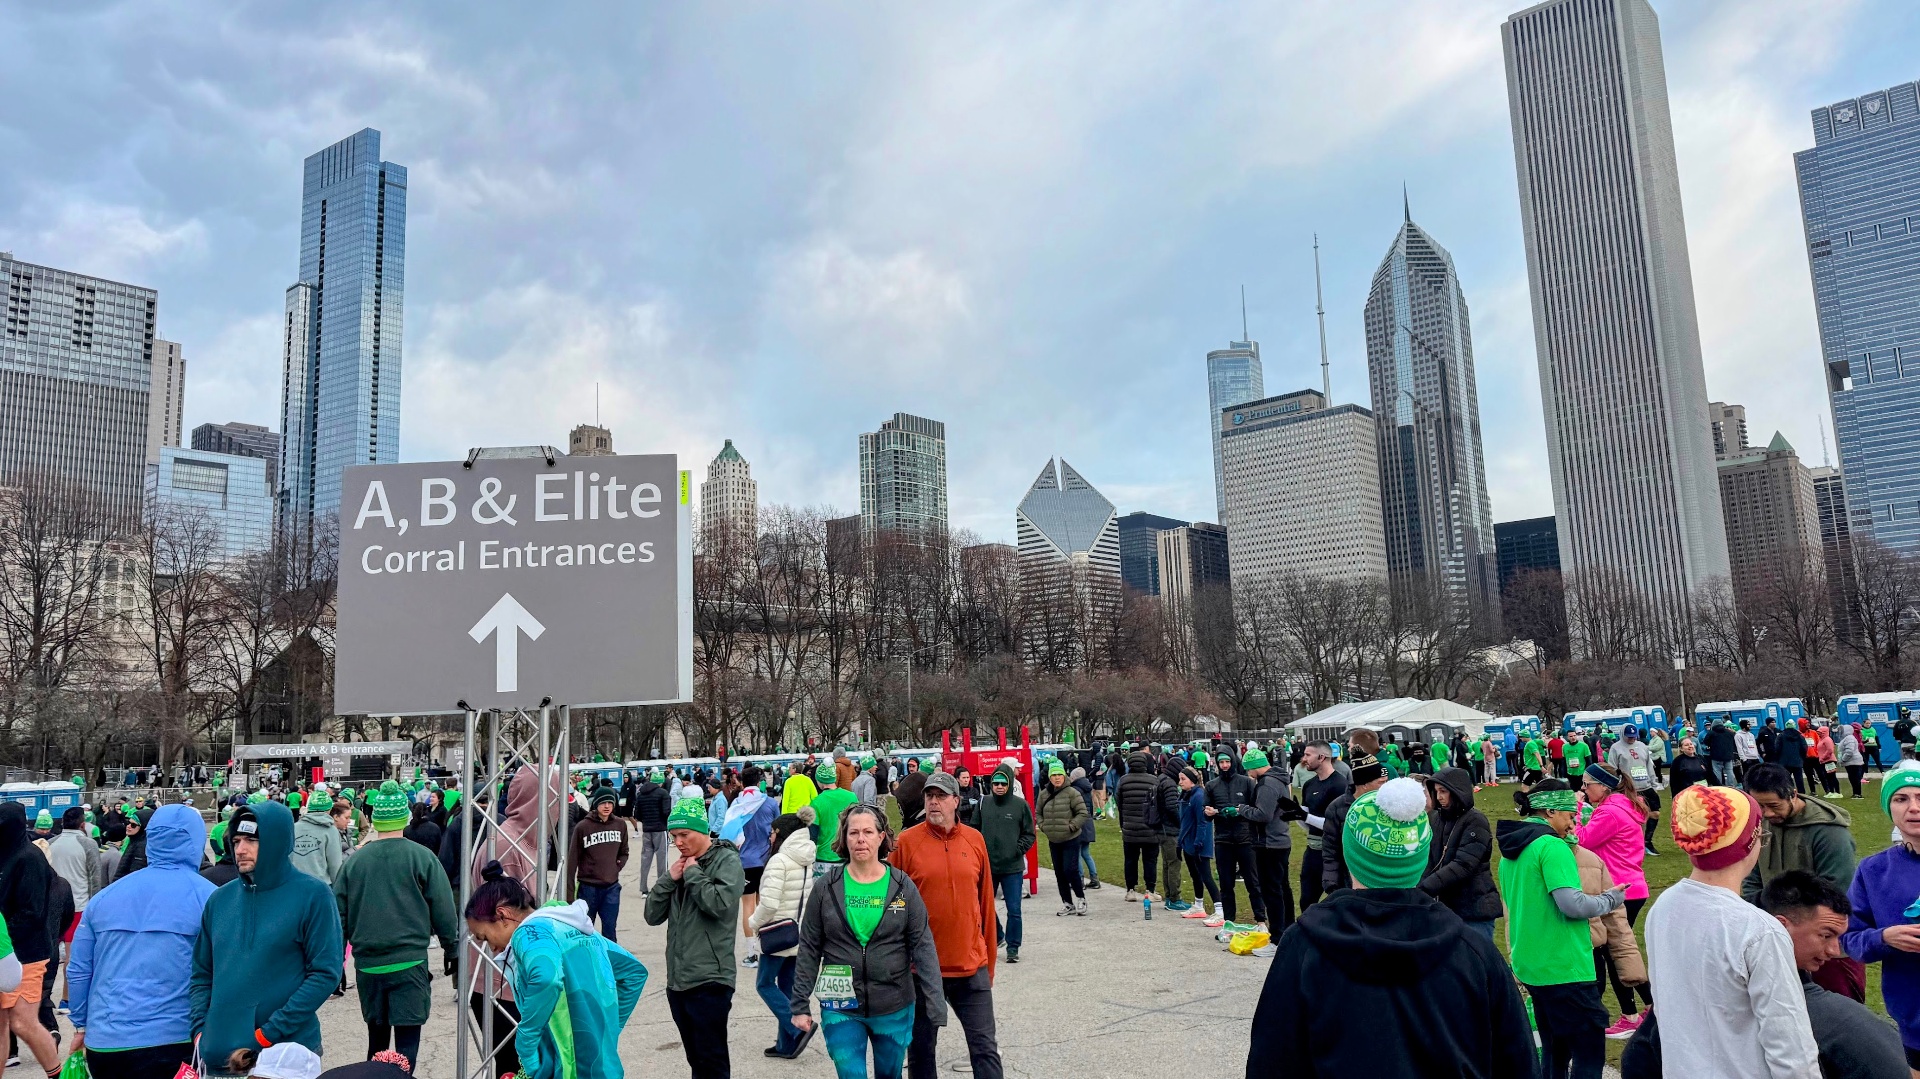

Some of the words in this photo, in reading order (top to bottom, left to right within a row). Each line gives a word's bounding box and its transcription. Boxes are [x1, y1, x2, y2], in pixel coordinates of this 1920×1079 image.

[1248, 400, 1300, 419] Prudential
[353, 480, 409, 536] A,
[421, 477, 457, 526] B
[471, 476, 518, 526] &
[535, 470, 662, 521] Elite
[361, 540, 465, 574] Corral
[479, 539, 655, 569] Entrances
[268, 746, 306, 756] Corrals
[309, 746, 317, 755] A
[319, 745, 328, 755] &
[331, 745, 338, 754] B
[341, 745, 385, 754] entrance
[583, 831, 622, 848] LEHIGH
[564, 930, 582, 939] TEA
[821, 978, 852, 993] 24693
